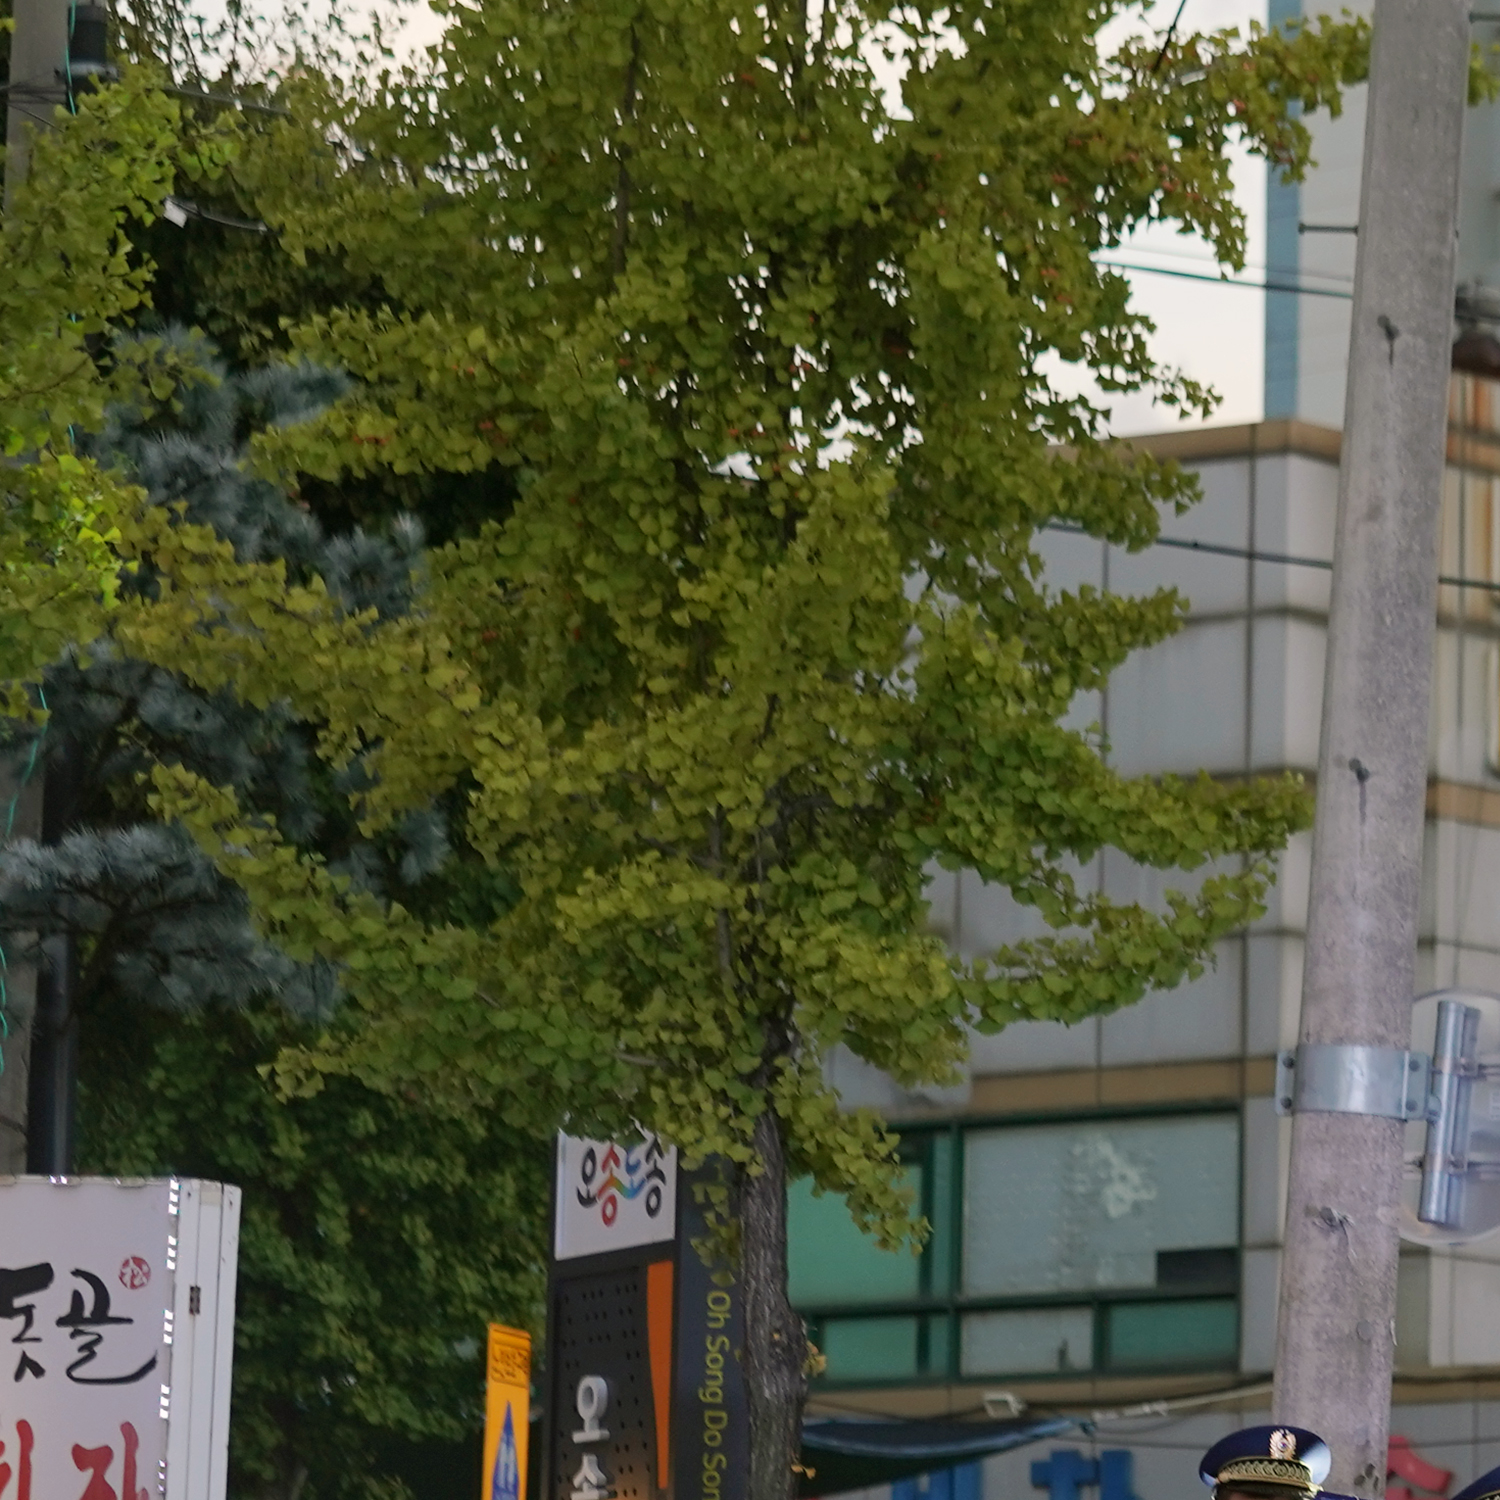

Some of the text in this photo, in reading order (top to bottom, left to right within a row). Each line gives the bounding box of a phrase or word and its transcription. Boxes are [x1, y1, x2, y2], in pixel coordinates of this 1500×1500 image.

[576, 1140, 667, 1228] 오송도송
[707, 1291, 731, 1329] Oh
[699, 1337, 730, 1404] Song
[703, 1410, 729, 1448] Do
